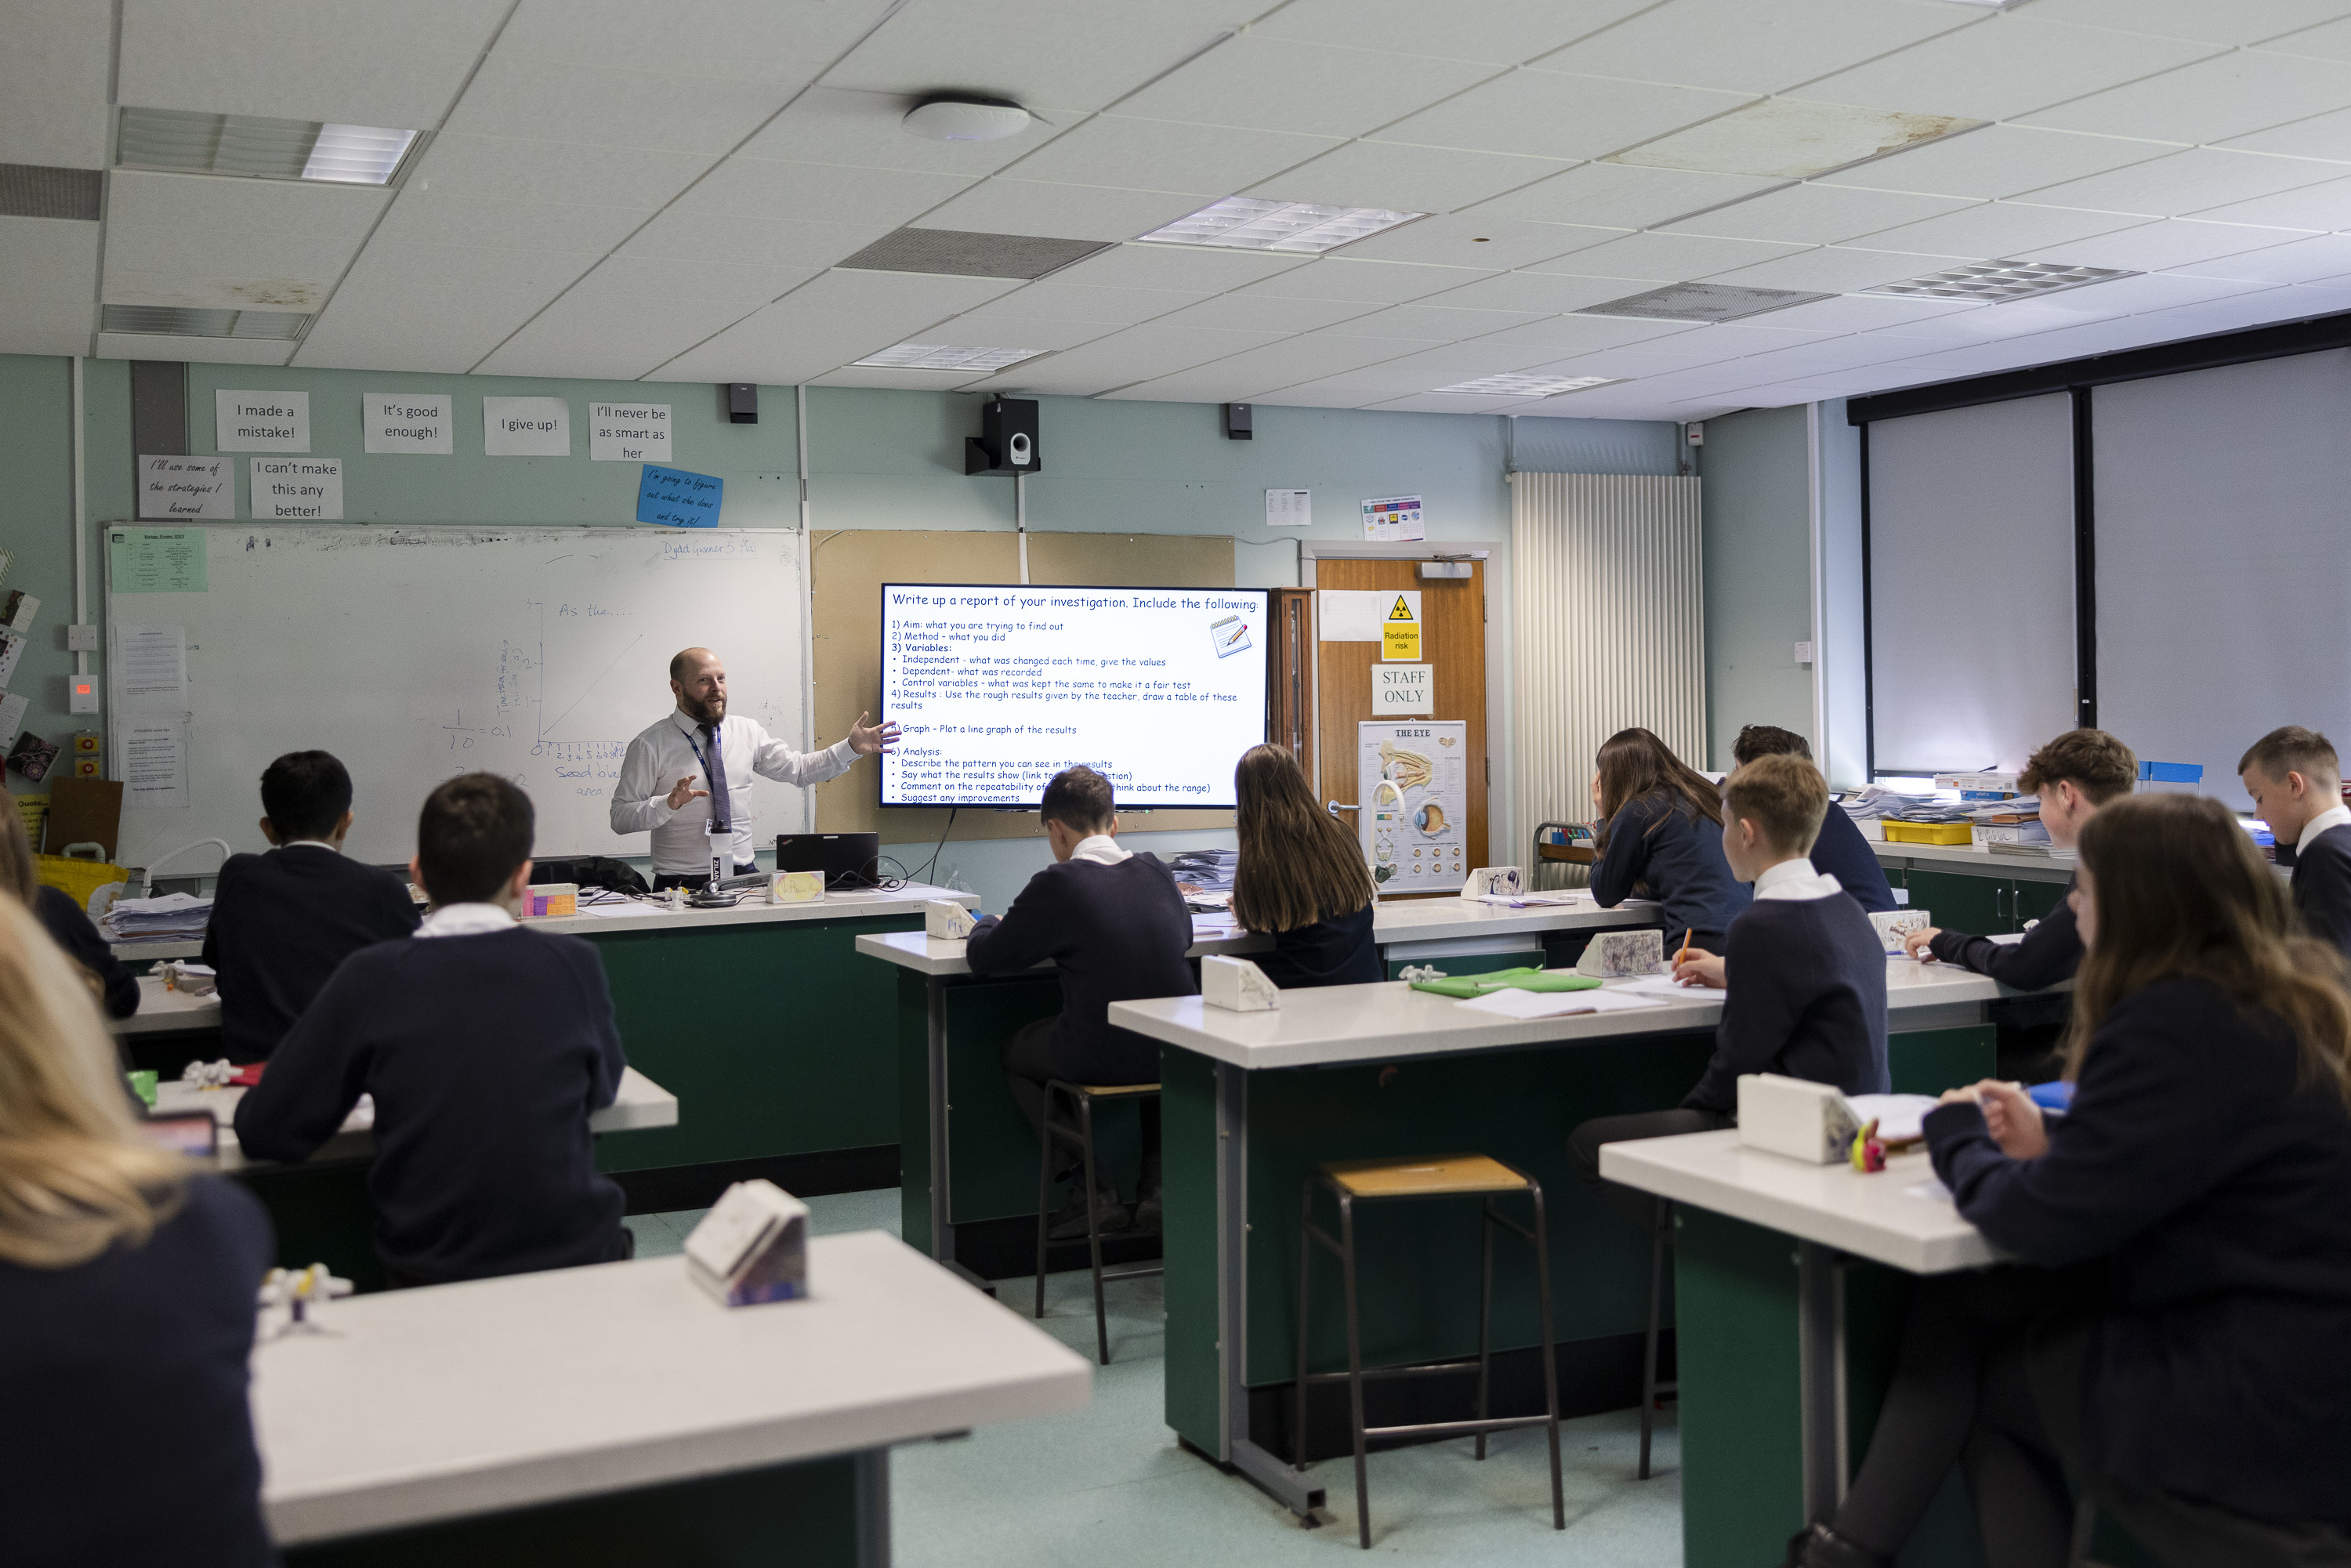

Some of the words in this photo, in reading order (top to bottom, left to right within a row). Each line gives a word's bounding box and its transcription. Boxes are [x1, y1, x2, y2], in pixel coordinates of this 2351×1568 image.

[237, 404, 241, 415] I
[245, 405, 283, 417] made
[287, 408, 294, 417] a
[384, 404, 403, 415] It's
[407, 406, 438, 419] good
[597, 407, 610, 417] I'll
[615, 409, 648, 418] never
[651, 409, 665, 419] be
[502, 418, 505, 429] I
[509, 418, 534, 432] give
[538, 419, 557, 433] up!
[237, 426, 295, 438] mistake!
[385, 426, 437, 440] enough!
[615, 429, 649, 439] smart
[623, 447, 643, 458] her
[150, 459, 168, 470] I'll
[210, 462, 220, 476] of
[257, 462, 260, 473] I
[265, 462, 298, 474] can't
[302, 464, 337, 475] make
[648, 469, 660, 480] I'm
[661, 476, 681, 487] going
[684, 476, 692, 485] to
[693, 478, 716, 491] figure
[150, 481, 164, 491] the
[168, 483, 212, 496] strategies
[272, 483, 296, 494] this
[300, 486, 324, 498] any
[661, 493, 679, 502] what
[682, 496, 694, 505] she
[697, 498, 714, 509] does
[169, 502, 203, 513] learned
[276, 505, 321, 516] better!
[672, 514, 685, 525] try
[687, 516, 700, 526] it!
[726, 541, 734, 553] 5
[893, 594, 928, 604] Write
[933, 597, 945, 608] up
[961, 596, 999, 608] report
[1003, 596, 1016, 607] of
[1020, 599, 1046, 609] your
[1051, 596, 1128, 610] investigation.
[1133, 597, 1176, 608] Include
[1181, 598, 1201, 608] the
[1205, 598, 1258, 613] following:
[559, 603, 578, 617] As
[893, 620, 900, 630] 1)
[986, 622, 1012, 632] trying
[892, 632, 901, 641] 2)
[904, 632, 939, 640] Method
[892, 643, 901, 653] 3)
[906, 643, 951, 652] Variables:
[903, 655, 959, 665] Independent
[1013, 657, 1049, 667] changed
[903, 667, 954, 677] Dependent-
[1383, 671, 1425, 683] STAFF
[1032, 680, 1051, 690] kept
[1154, 680, 1169, 689] fair
[892, 690, 900, 699] 4)
[984, 691, 1008, 701] rough
[1071, 692, 1081, 701] by
[1103, 692, 1139, 701] teacher,
[1385, 690, 1424, 703] ONLY
[903, 724, 929, 735] Graph
[987, 726, 1011, 735] graph
[903, 748, 942, 758] Analysis:
[963, 760, 996, 770] pattern
